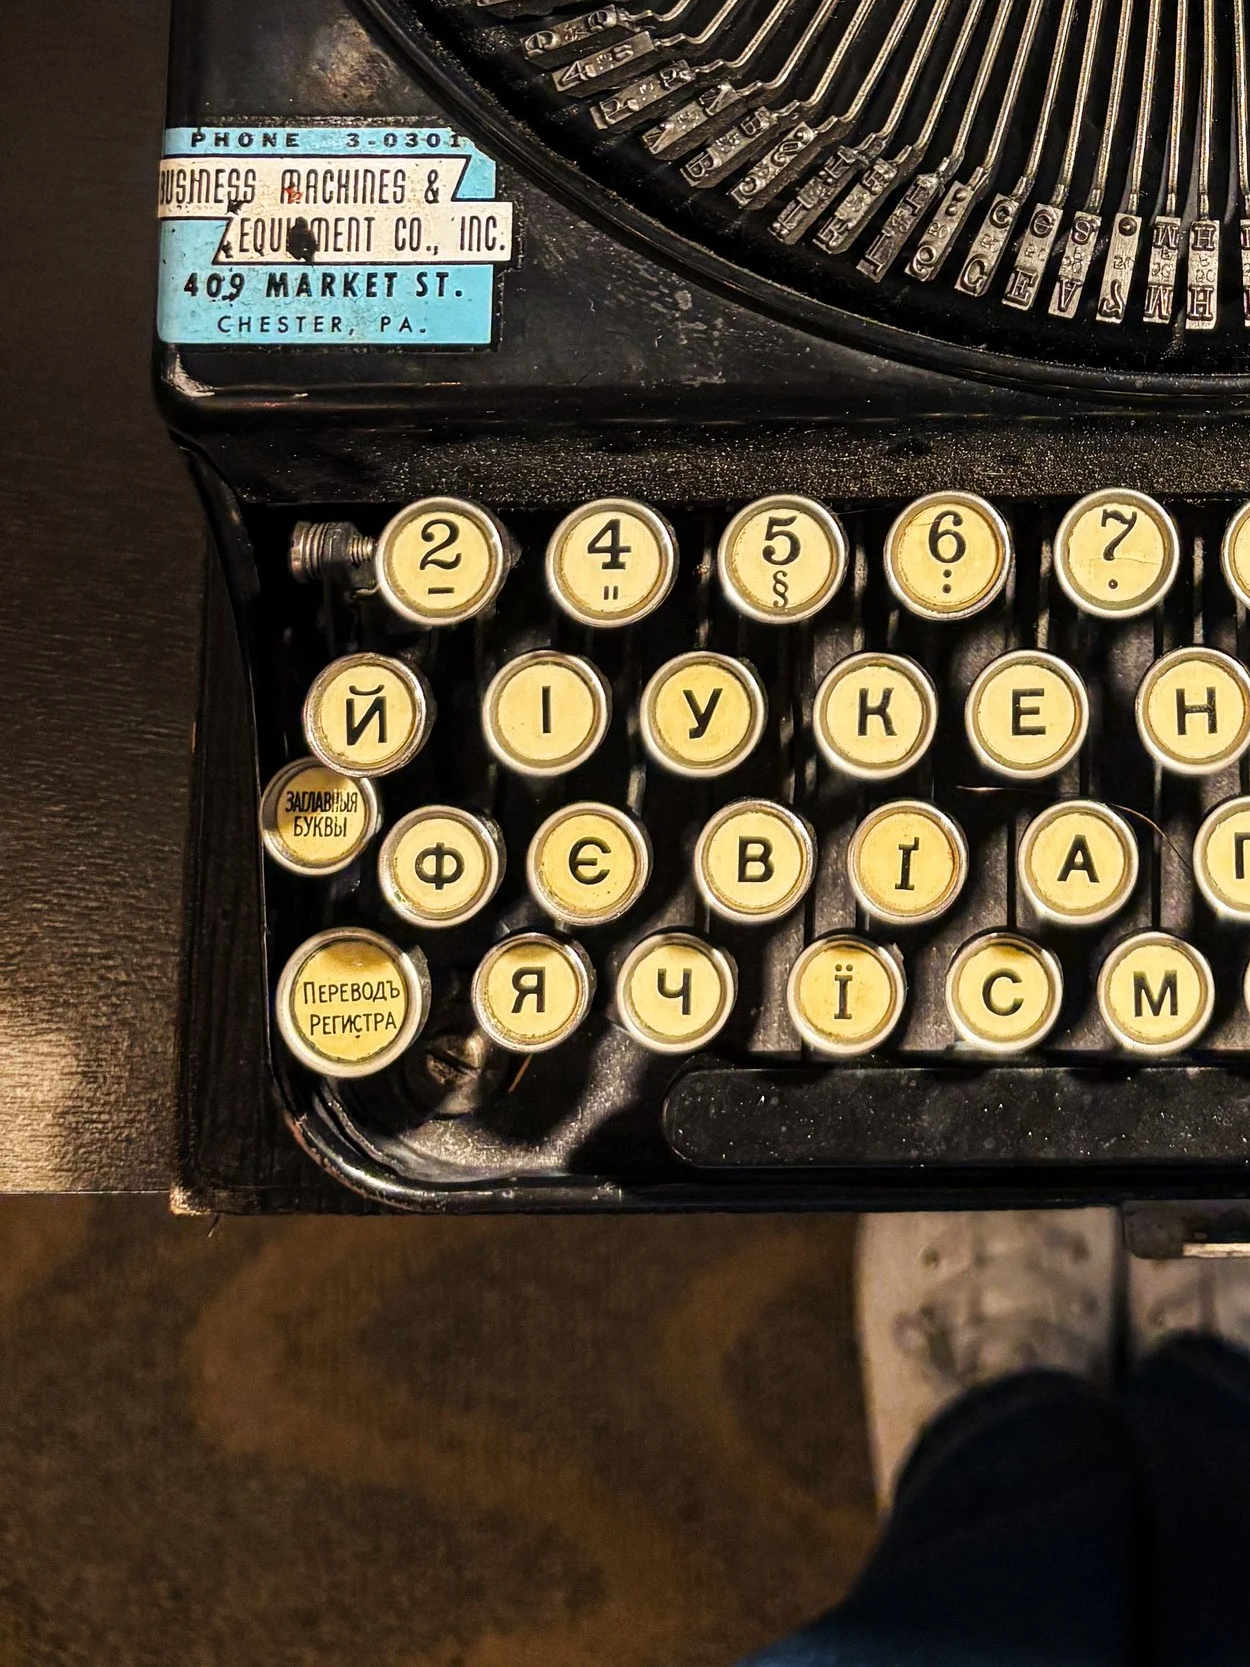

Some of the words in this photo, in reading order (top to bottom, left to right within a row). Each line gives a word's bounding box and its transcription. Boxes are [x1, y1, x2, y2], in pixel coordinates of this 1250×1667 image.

[190, 132, 300, 148] PHONE
[346, 132, 463, 148] 3-0301
[281, 169, 406, 204] MACHINES
[424, 168, 440, 204] &
[394, 216, 439, 256] CO.,
[460, 215, 506, 251] INC.
[184, 272, 245, 299] 409
[266, 272, 398, 298] MARKET
[415, 271, 463, 298] ST.
[217, 316, 355, 336] CHESTER,
[380, 316, 427, 334] PA.
[420, 519, 462, 572] 2
[587, 519, 631, 570] 4
[762, 516, 800, 566] 5
[929, 511, 966, 563] 6
[1101, 509, 1138, 561] 7
[346, 685, 387, 745] Й
[294, 816, 347, 838] БУКВЫ
[415, 843, 464, 890] Ф
[569, 837, 611, 885] Є
[511, 967, 545, 1013] Я
[658, 969, 692, 1015] Ч
[834, 964, 853, 1019] Ї
